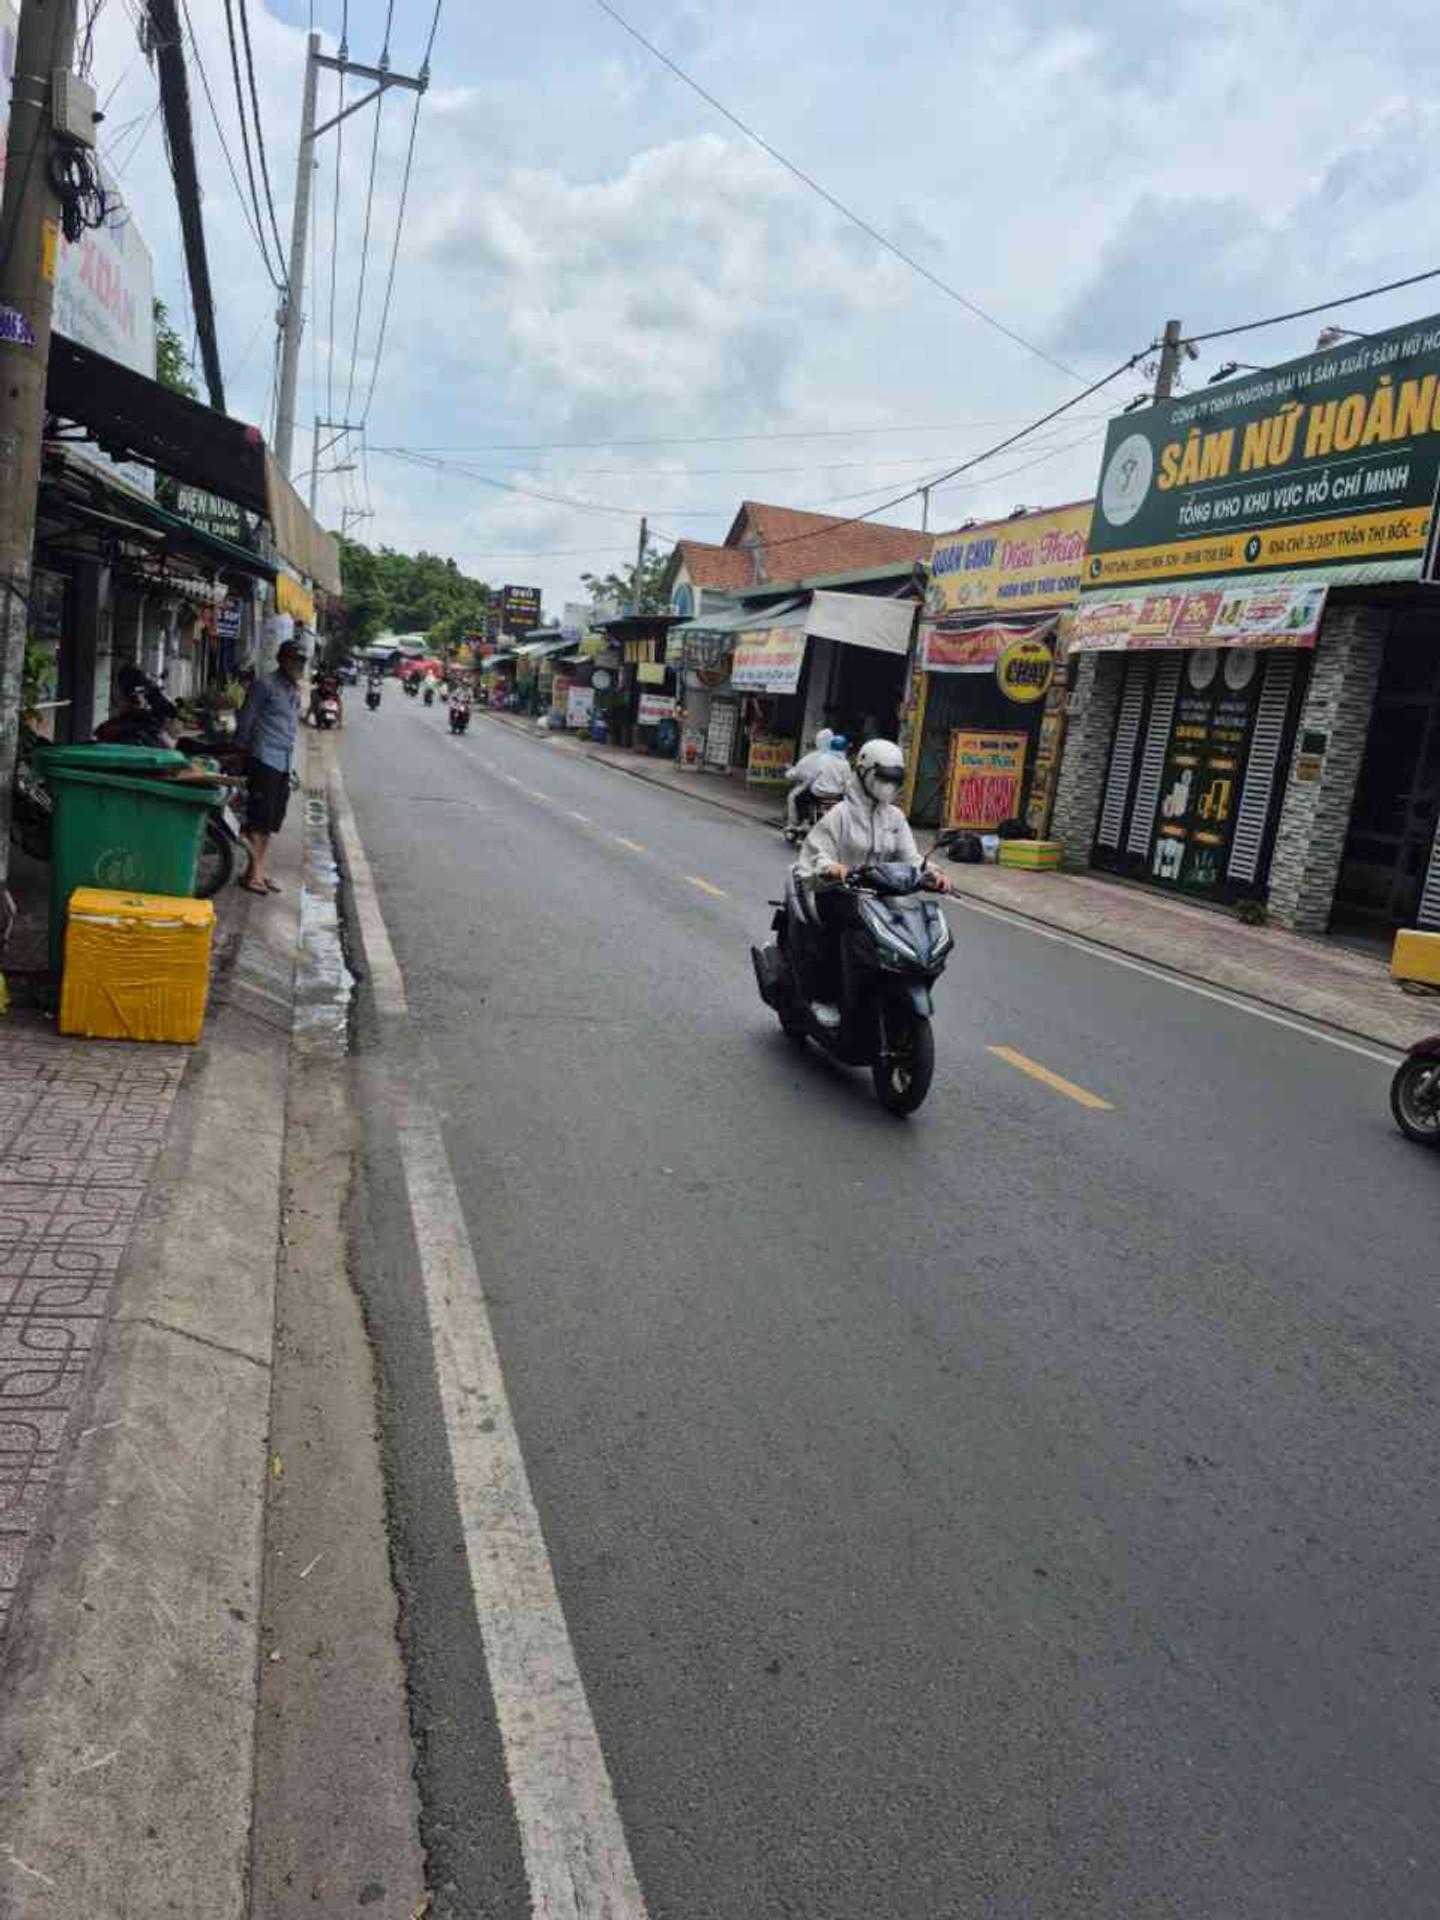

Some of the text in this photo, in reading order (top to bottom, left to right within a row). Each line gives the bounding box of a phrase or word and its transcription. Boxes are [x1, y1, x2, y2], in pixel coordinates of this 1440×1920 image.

[1298, 364, 1312, 388] VÀ
[1372, 340, 1400, 368] SÂM
[1157, 425, 1234, 490] SÂM
[1239, 402, 1307, 473] NỮ
[1177, 464, 1411, 526] TỔNG KHO KHU VỰC HỒ CHÍ MINH
[965, 539, 997, 569] CHAY
